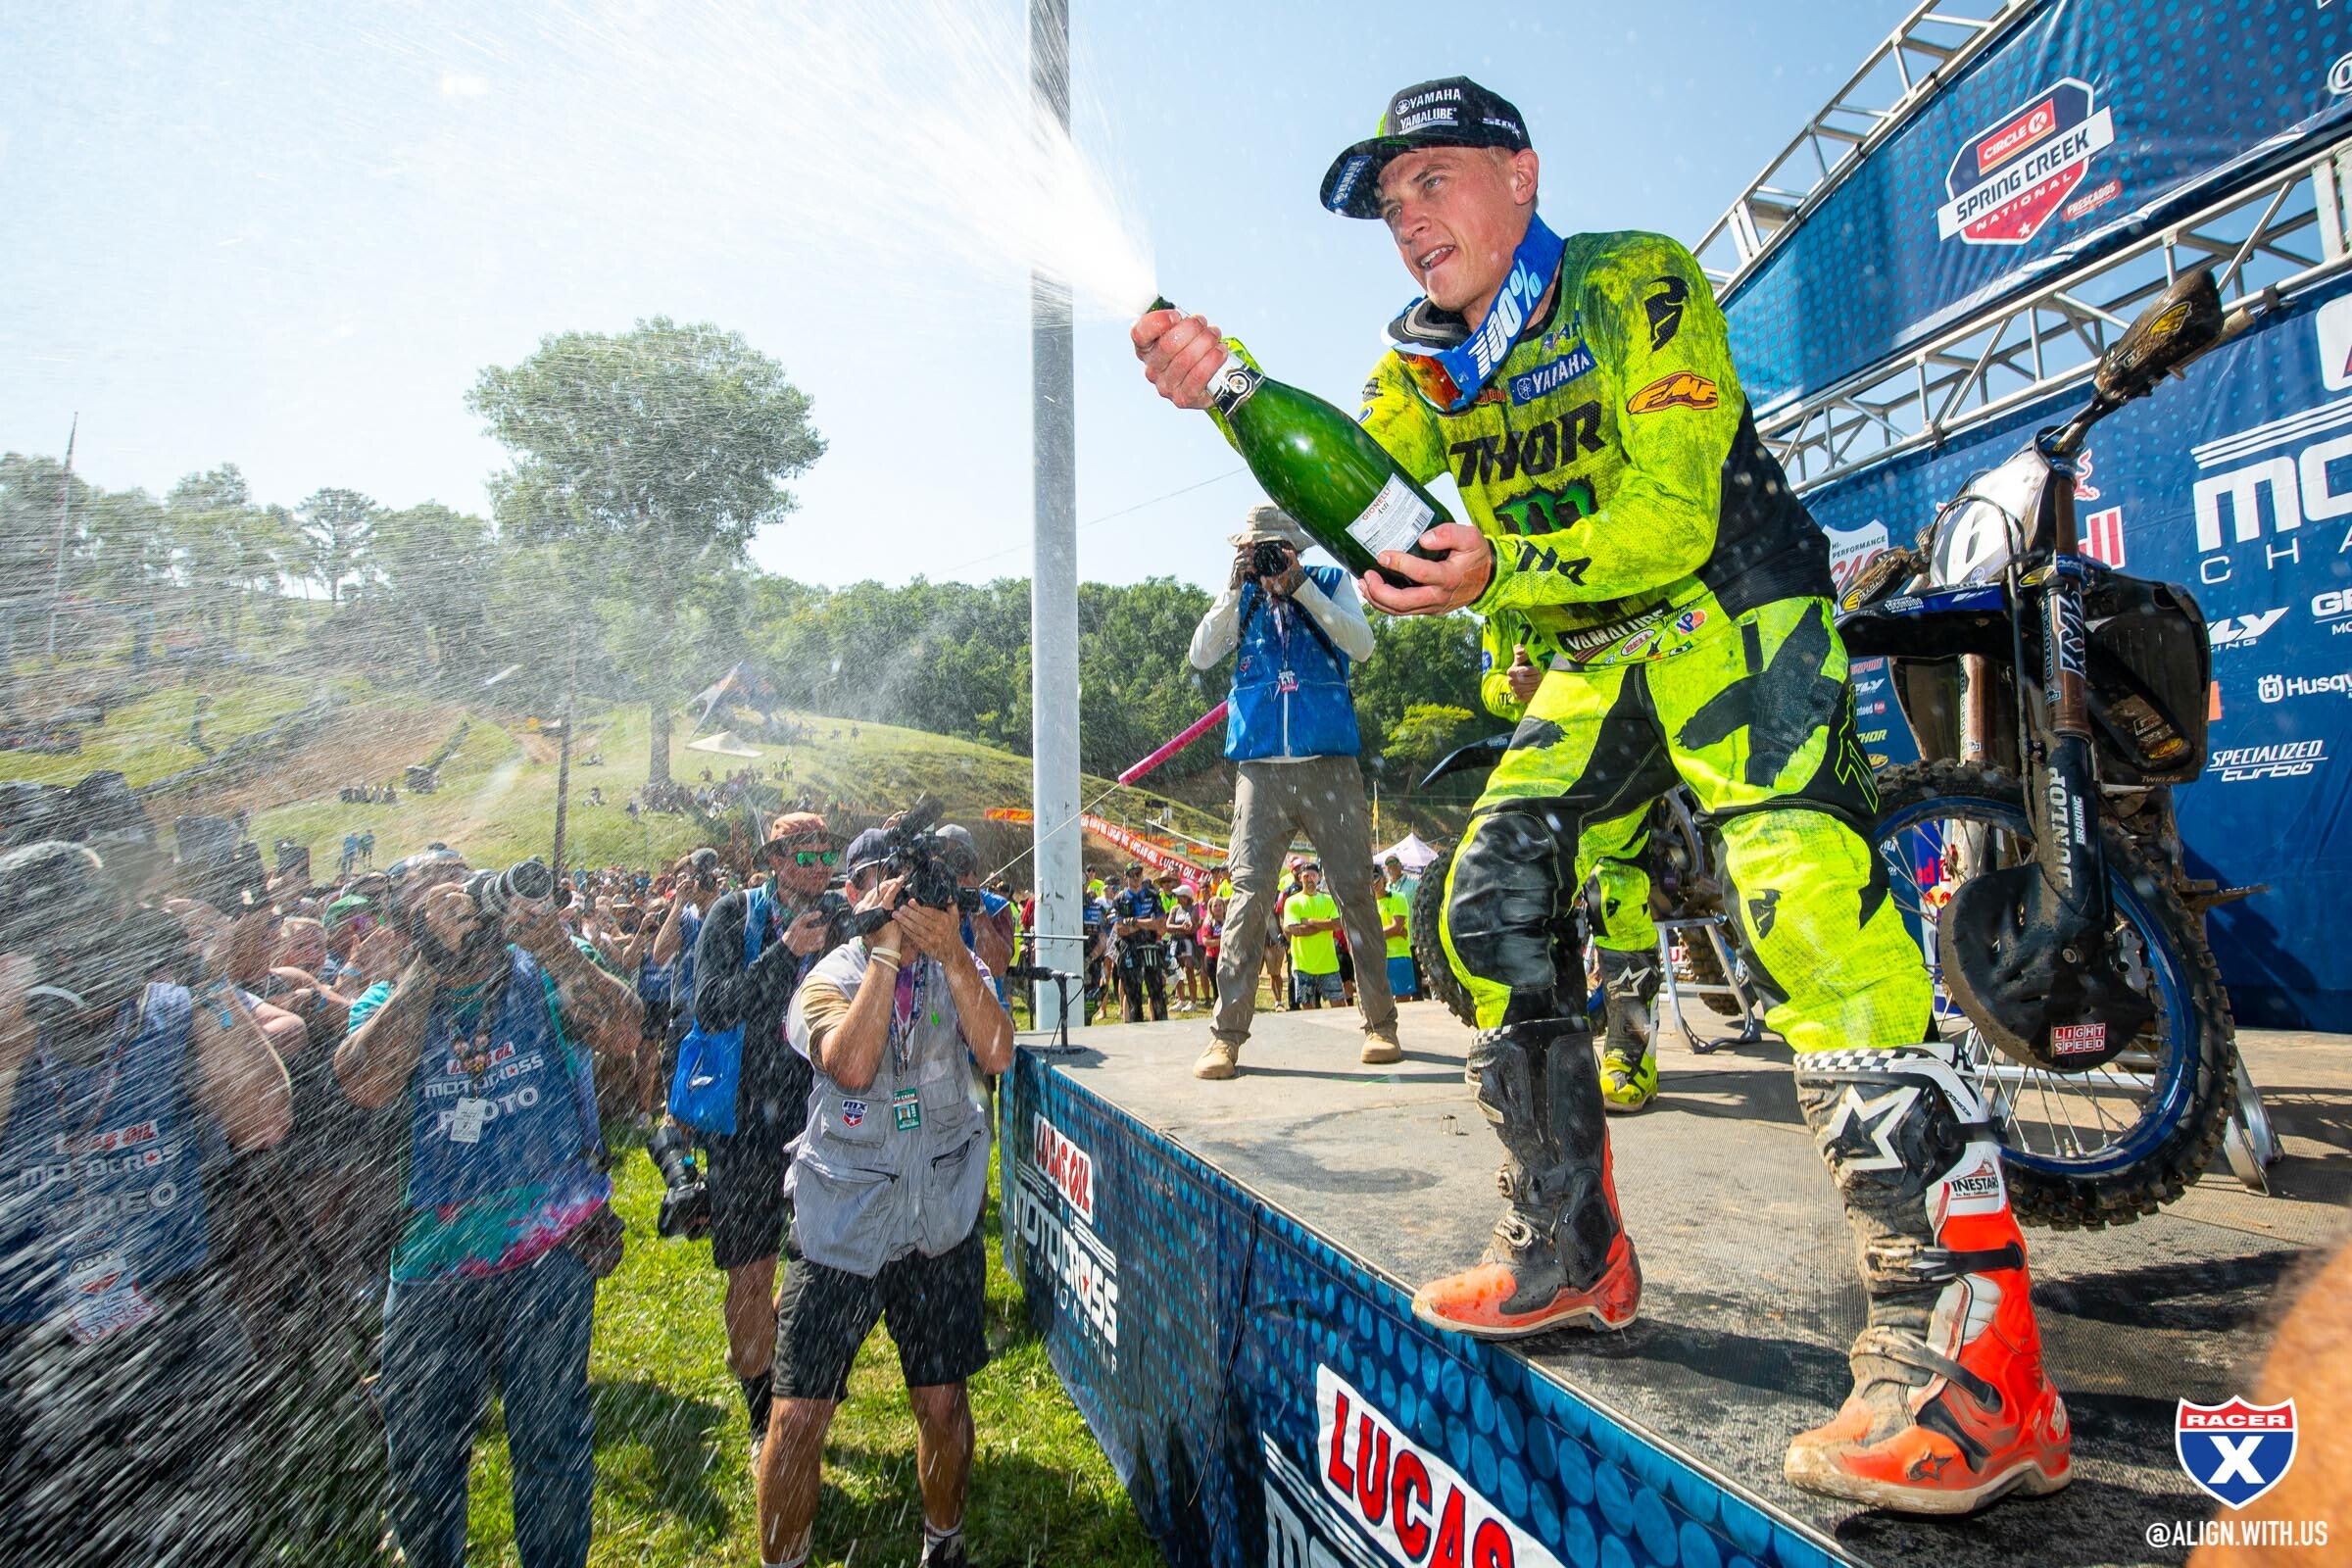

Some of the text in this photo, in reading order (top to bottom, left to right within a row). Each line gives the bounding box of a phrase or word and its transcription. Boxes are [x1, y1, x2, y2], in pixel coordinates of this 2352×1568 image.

[1409, 88, 1461, 108] YAMAHA
[1400, 108, 1455, 130] YAMALUBE
[1983, 126, 2028, 161] CIRCLE
[1957, 128, 2089, 223] SPRING CREEK
[1976, 173, 2073, 232] NATIONAL
[1468, 259, 1542, 380] 100%
[1449, 400, 1608, 487] THOR
[1362, 485, 1392, 521] GIONELLI
[1833, 535, 1886, 559] PERFORMANCE
[2209, 740, 2324, 768] SPECIALIZED
[2048, 767, 2073, 888] DUNLOP
[2072, 795, 2086, 847] BRAKING
[1130, 840, 1158, 863] LUCAS OIL
[1183, 865, 1196, 880] OIL
[2054, 1039, 2103, 1053] SPEED
[2055, 1026, 2103, 1039] LIGHT
[495, 1043, 513, 1062] OIL
[439, 1087, 539, 1127] POTO
[1034, 1124, 1091, 1214] LUCAS OIL
[1014, 1182, 1118, 1348] MOTOCROSS
